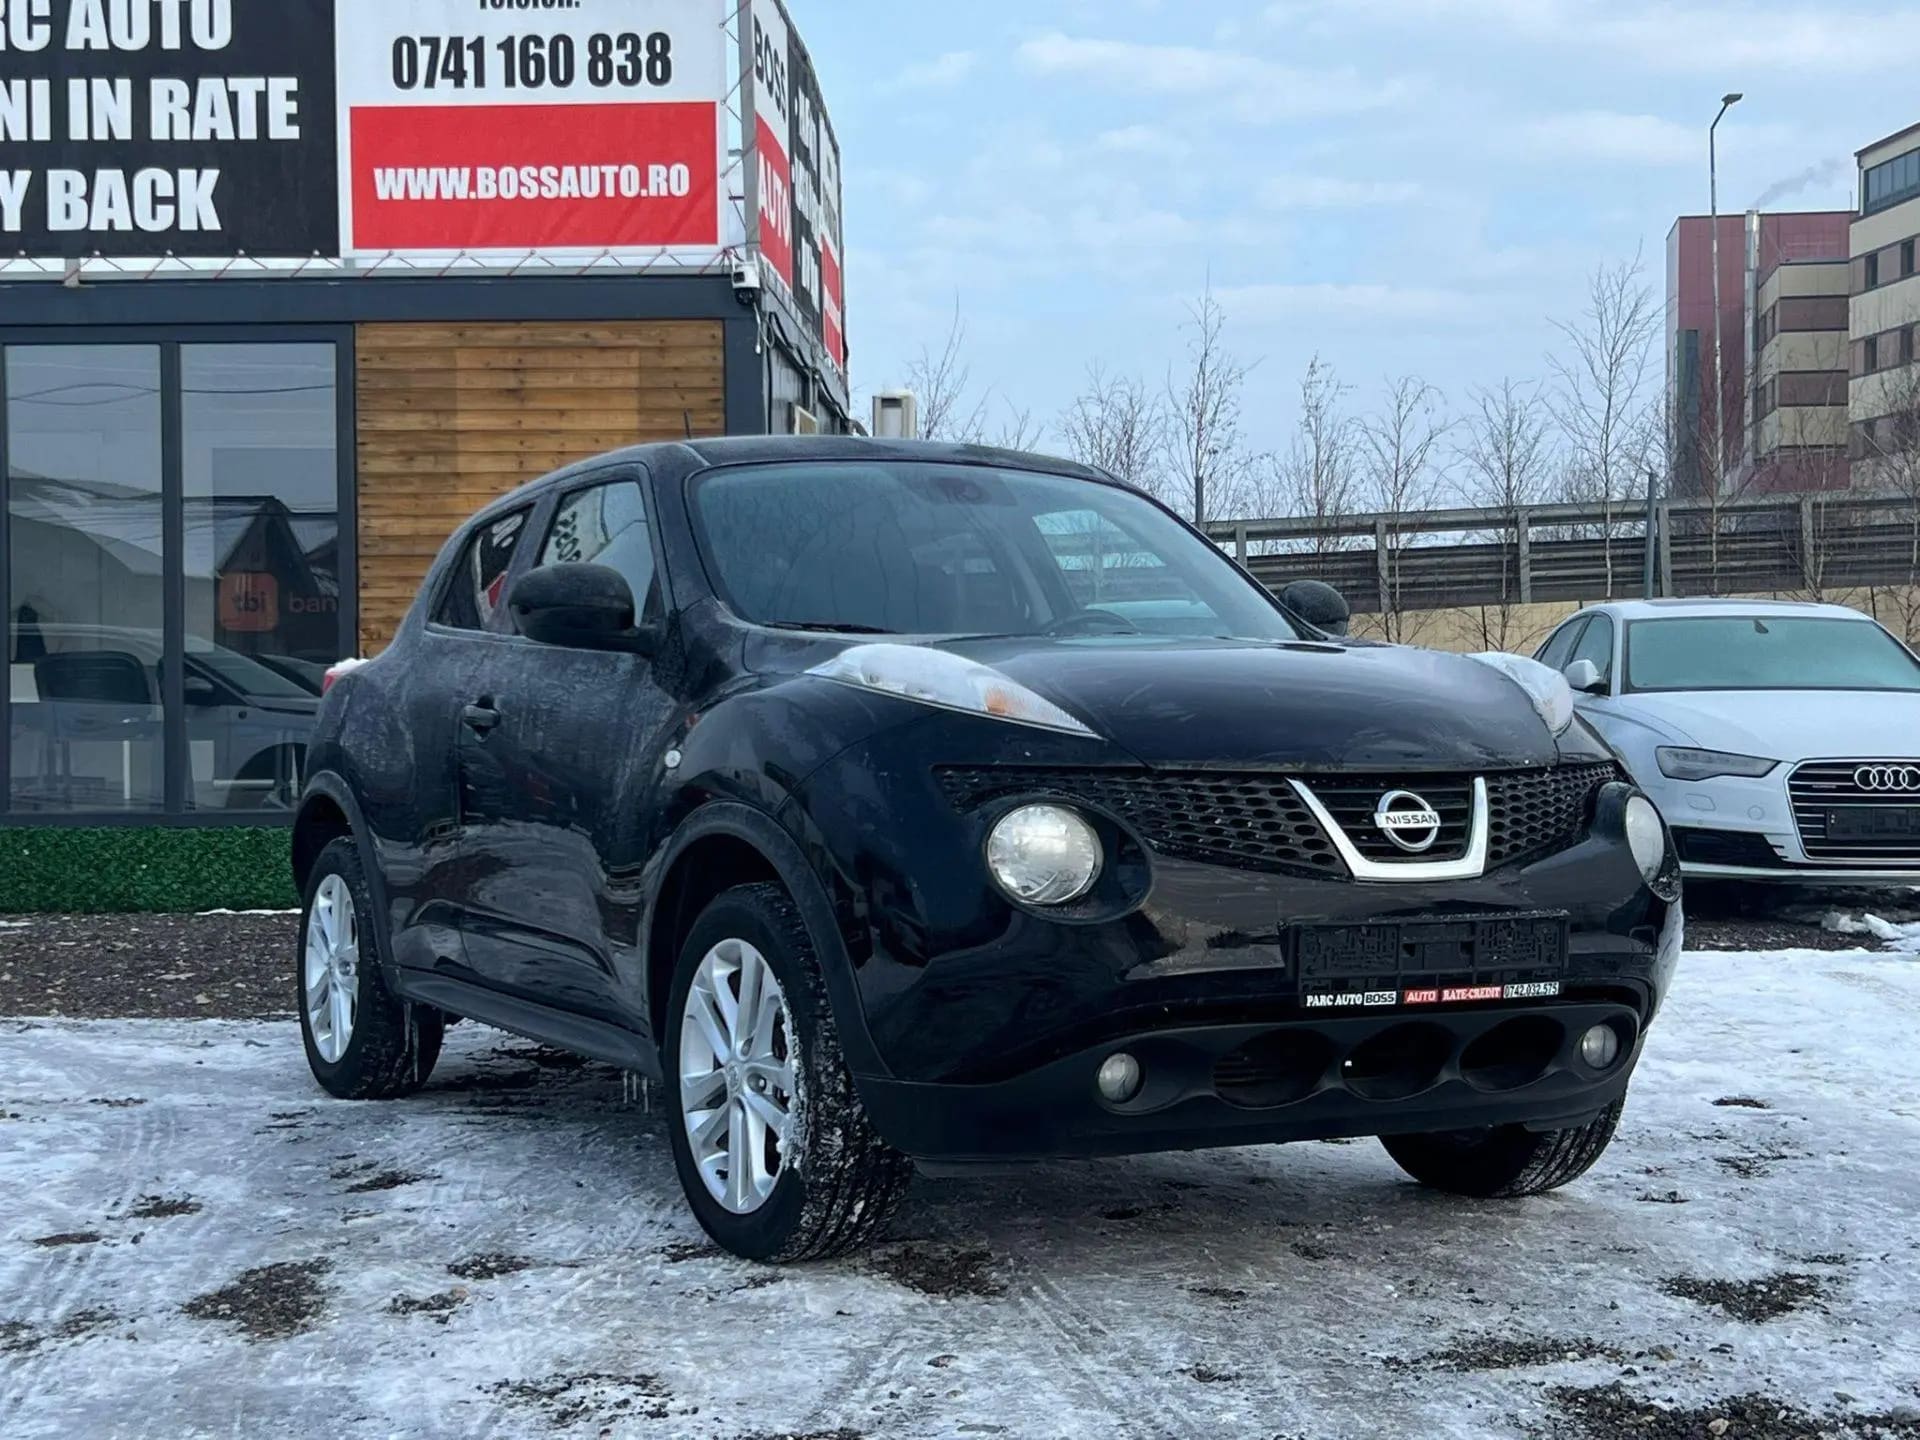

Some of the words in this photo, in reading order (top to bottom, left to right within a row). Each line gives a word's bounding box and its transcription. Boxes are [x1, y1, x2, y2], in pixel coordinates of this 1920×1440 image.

[0, 0, 51, 51] C
[65, 0, 233, 50] AUTO
[392, 36, 486, 90] 0741
[496, 34, 575, 88] 160
[588, 32, 672, 87] 838
[754, 14, 786, 122] BOSS
[68, 78, 132, 140] IN
[150, 77, 300, 140] RATE
[47, 168, 222, 232] BACK
[373, 163, 690, 200] WWW.BOSSAUTO.RO
[758, 152, 790, 248] AUTO
[1386, 814, 1437, 825] NISSAN
[1306, 995, 1334, 1007] PARC
[1334, 993, 1362, 1006] AUTO
[1366, 992, 1395, 1004] BOSS
[1406, 990, 1436, 1002] AUTO
[1442, 987, 1501, 1001] RATE-CREDIT
[1505, 983, 1559, 997] 0742.032.575
